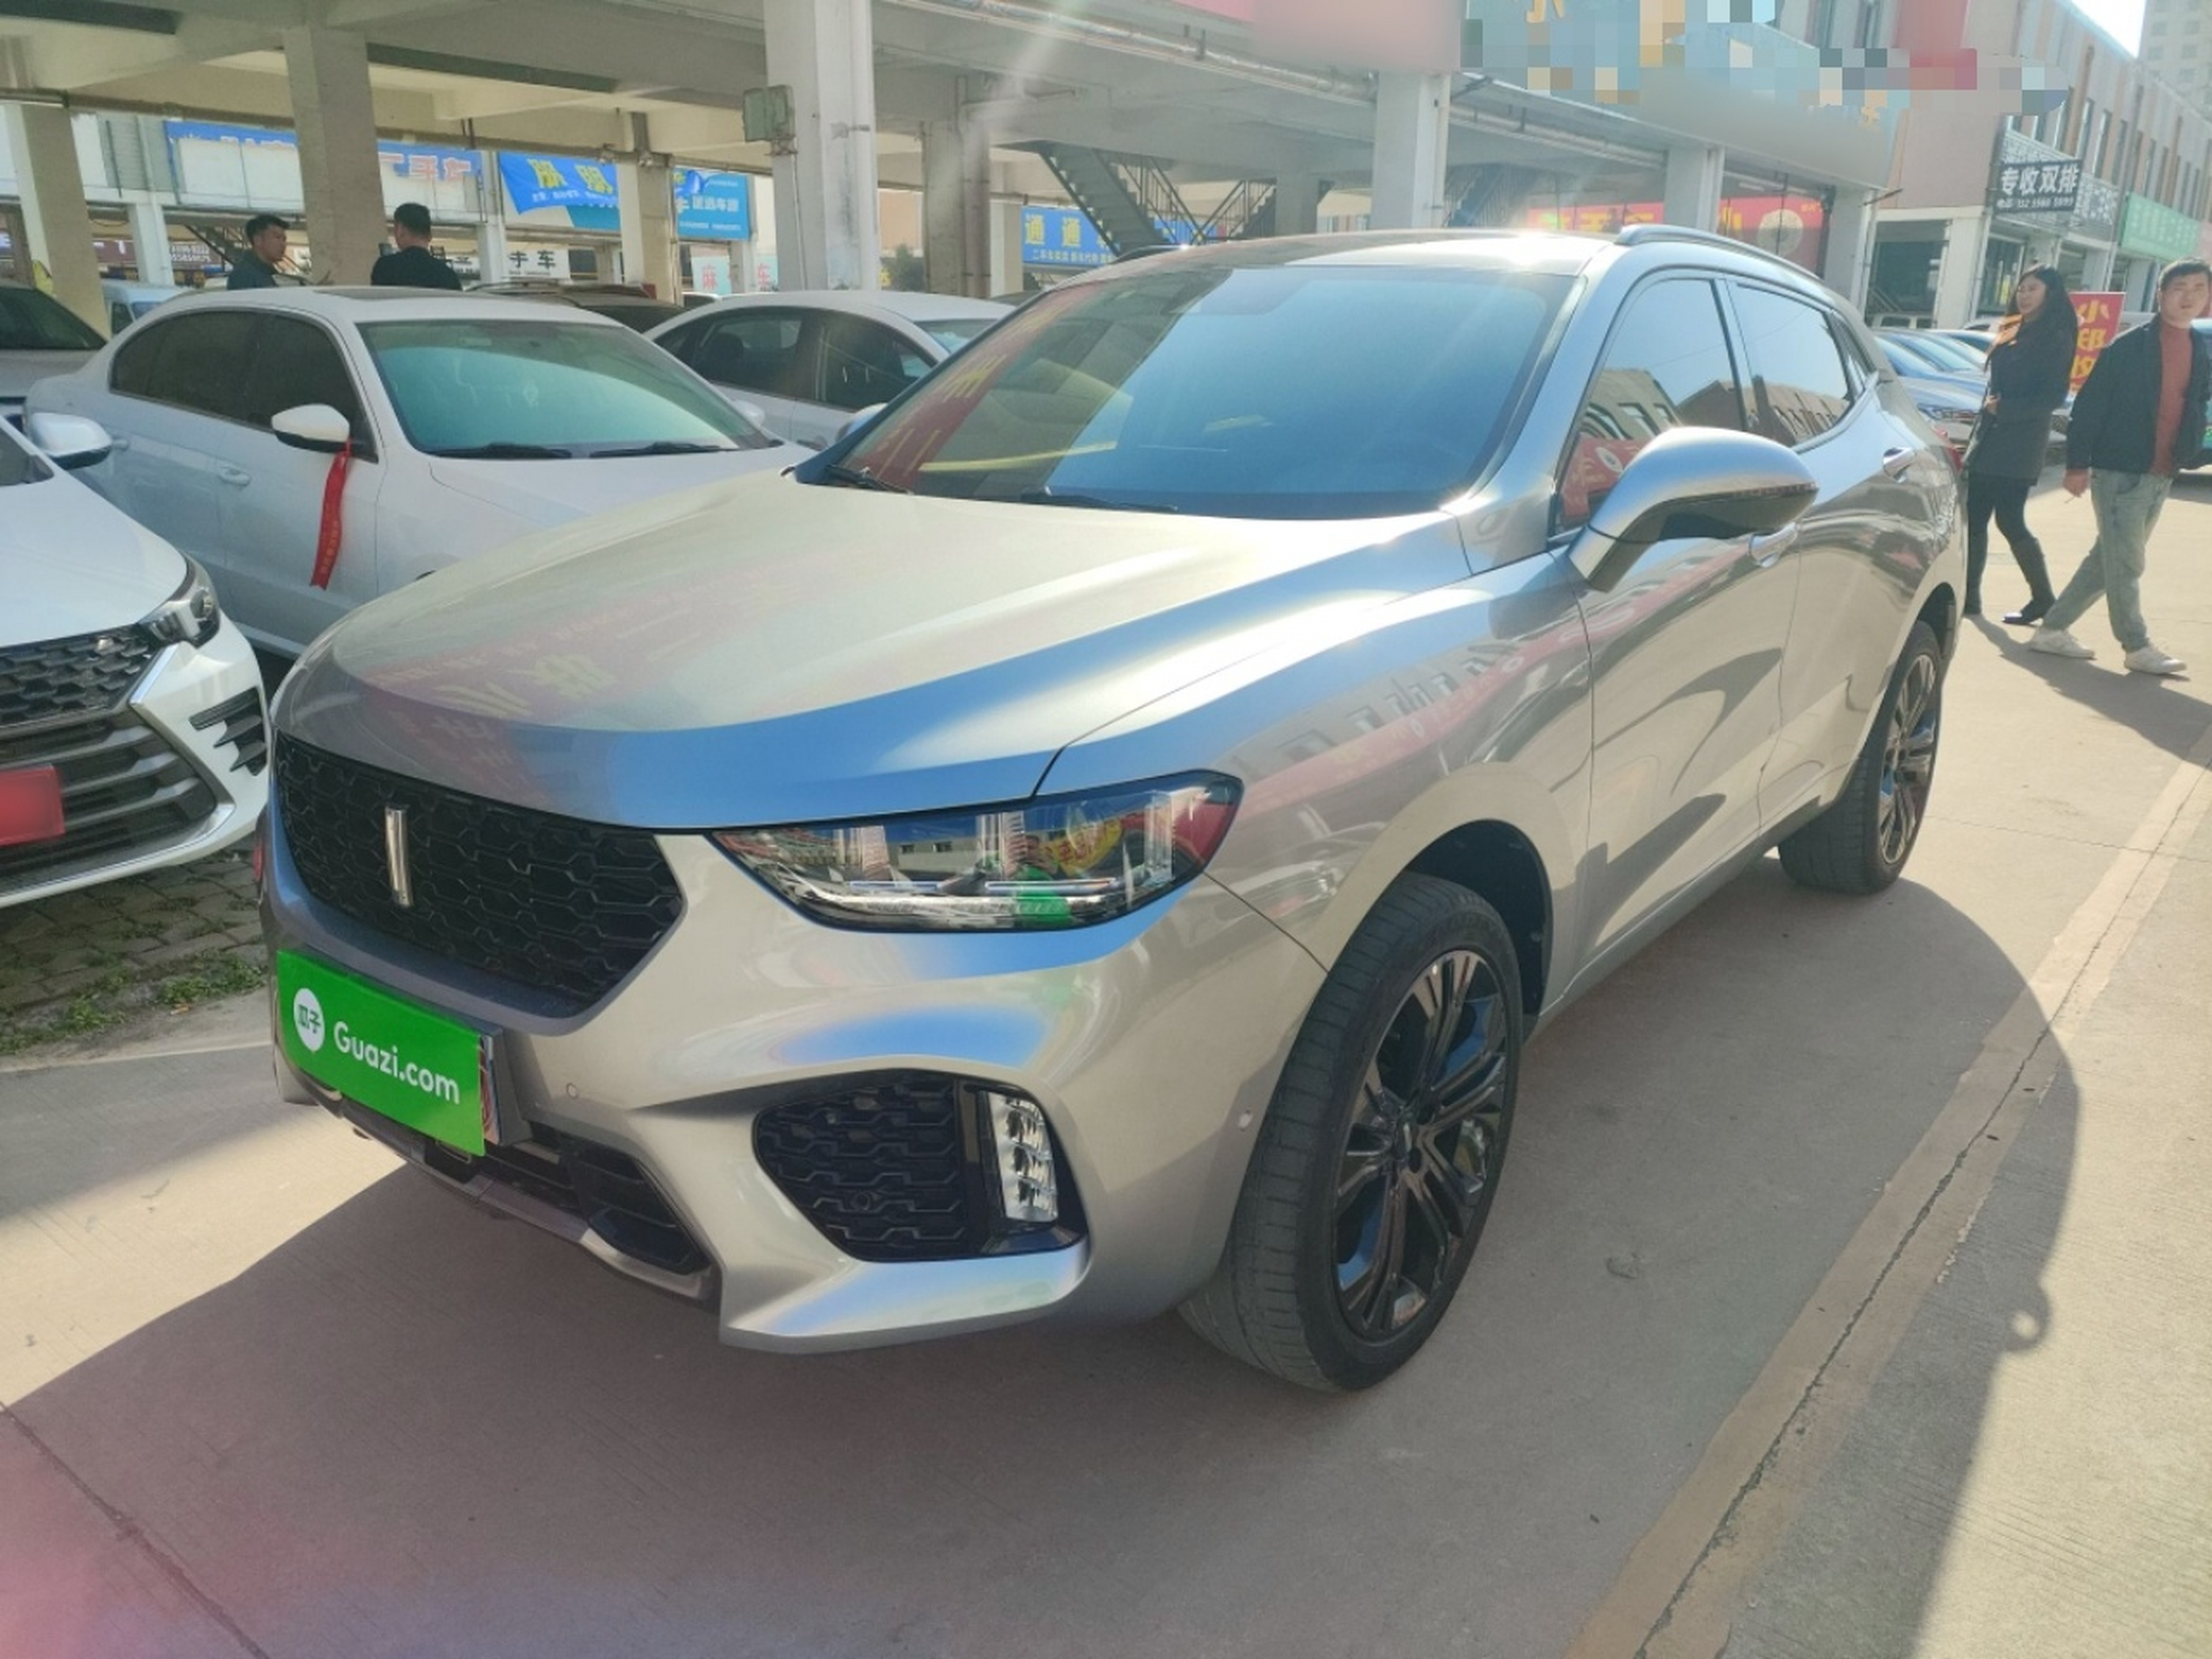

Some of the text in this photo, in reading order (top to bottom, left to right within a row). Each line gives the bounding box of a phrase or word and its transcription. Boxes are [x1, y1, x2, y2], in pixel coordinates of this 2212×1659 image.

[2001, 163, 2080, 196] 专收双排
[334, 1021, 460, 1104] Guazi.com
